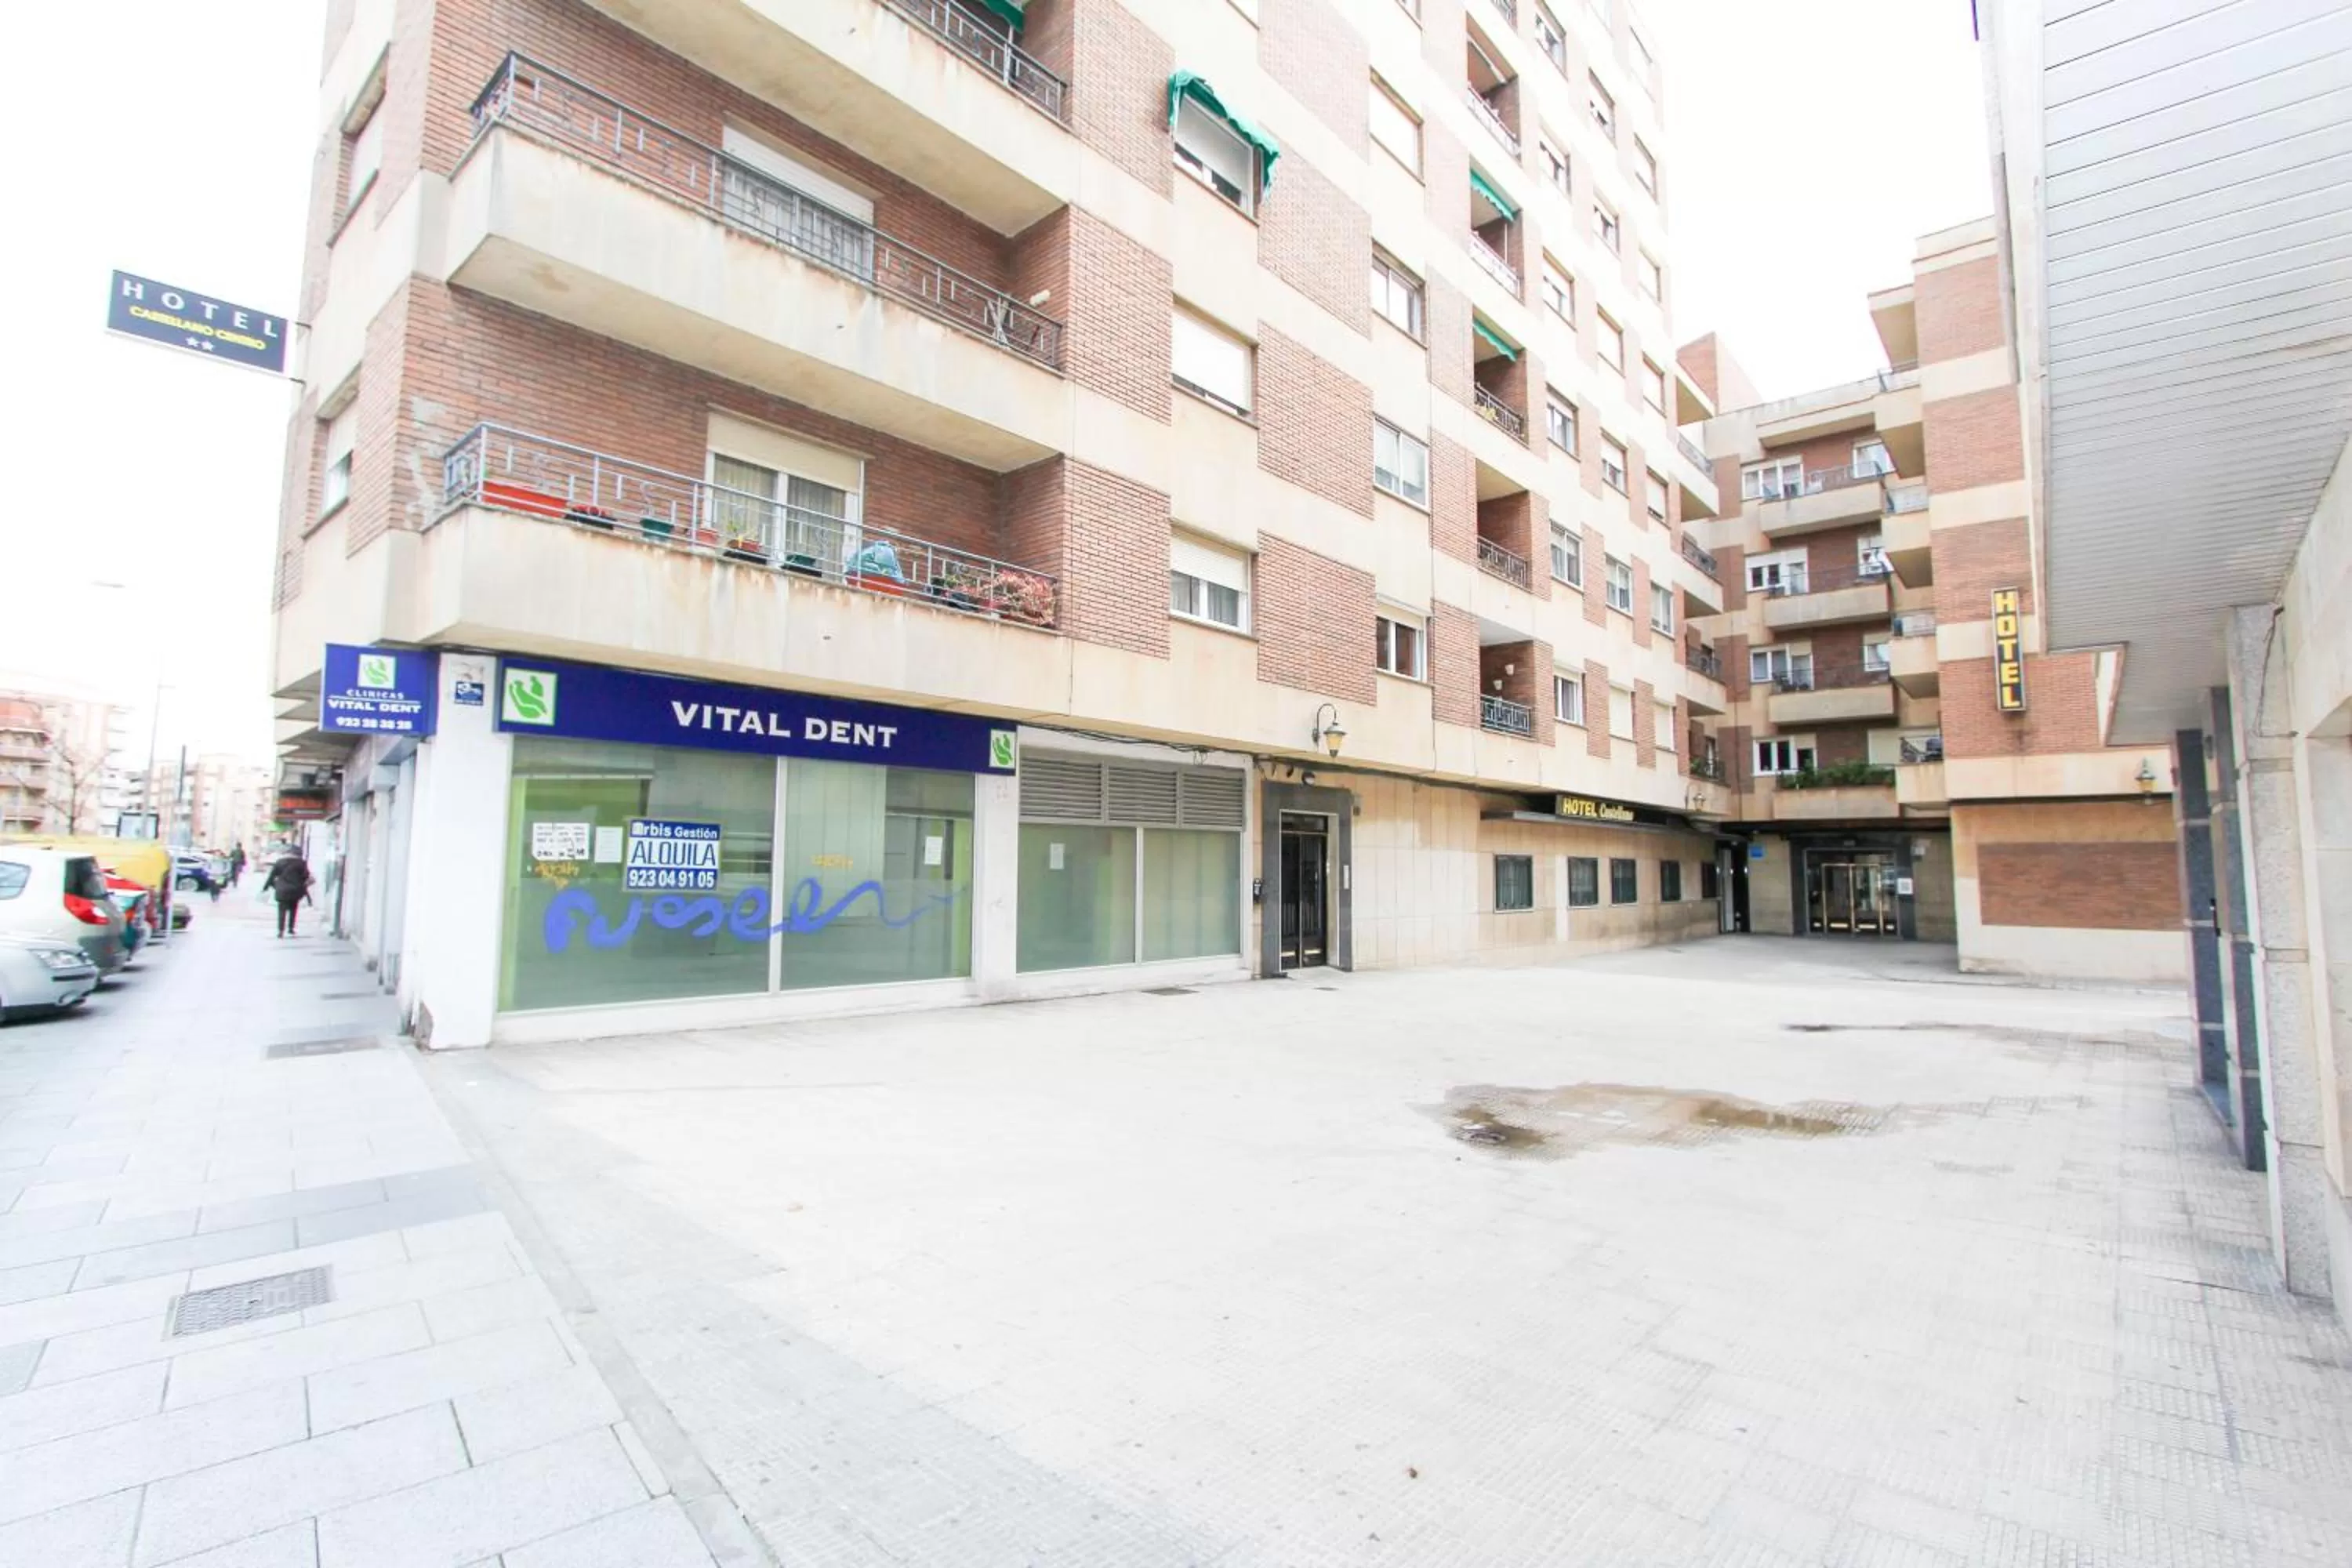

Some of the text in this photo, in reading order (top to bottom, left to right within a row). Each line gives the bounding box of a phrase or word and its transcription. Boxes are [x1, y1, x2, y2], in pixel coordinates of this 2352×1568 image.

[122, 280, 278, 337] HOTEL
[1994, 591, 2020, 709] HOTEL
[327, 699, 423, 714] VITAL DENT
[671, 700, 898, 749] VITAL DENT
[1563, 797, 1598, 817] HOTEL
[673, 826, 718, 840] Gestión
[631, 840, 717, 866] ALQUILA
[628, 869, 715, 889] 923 04 91 05
